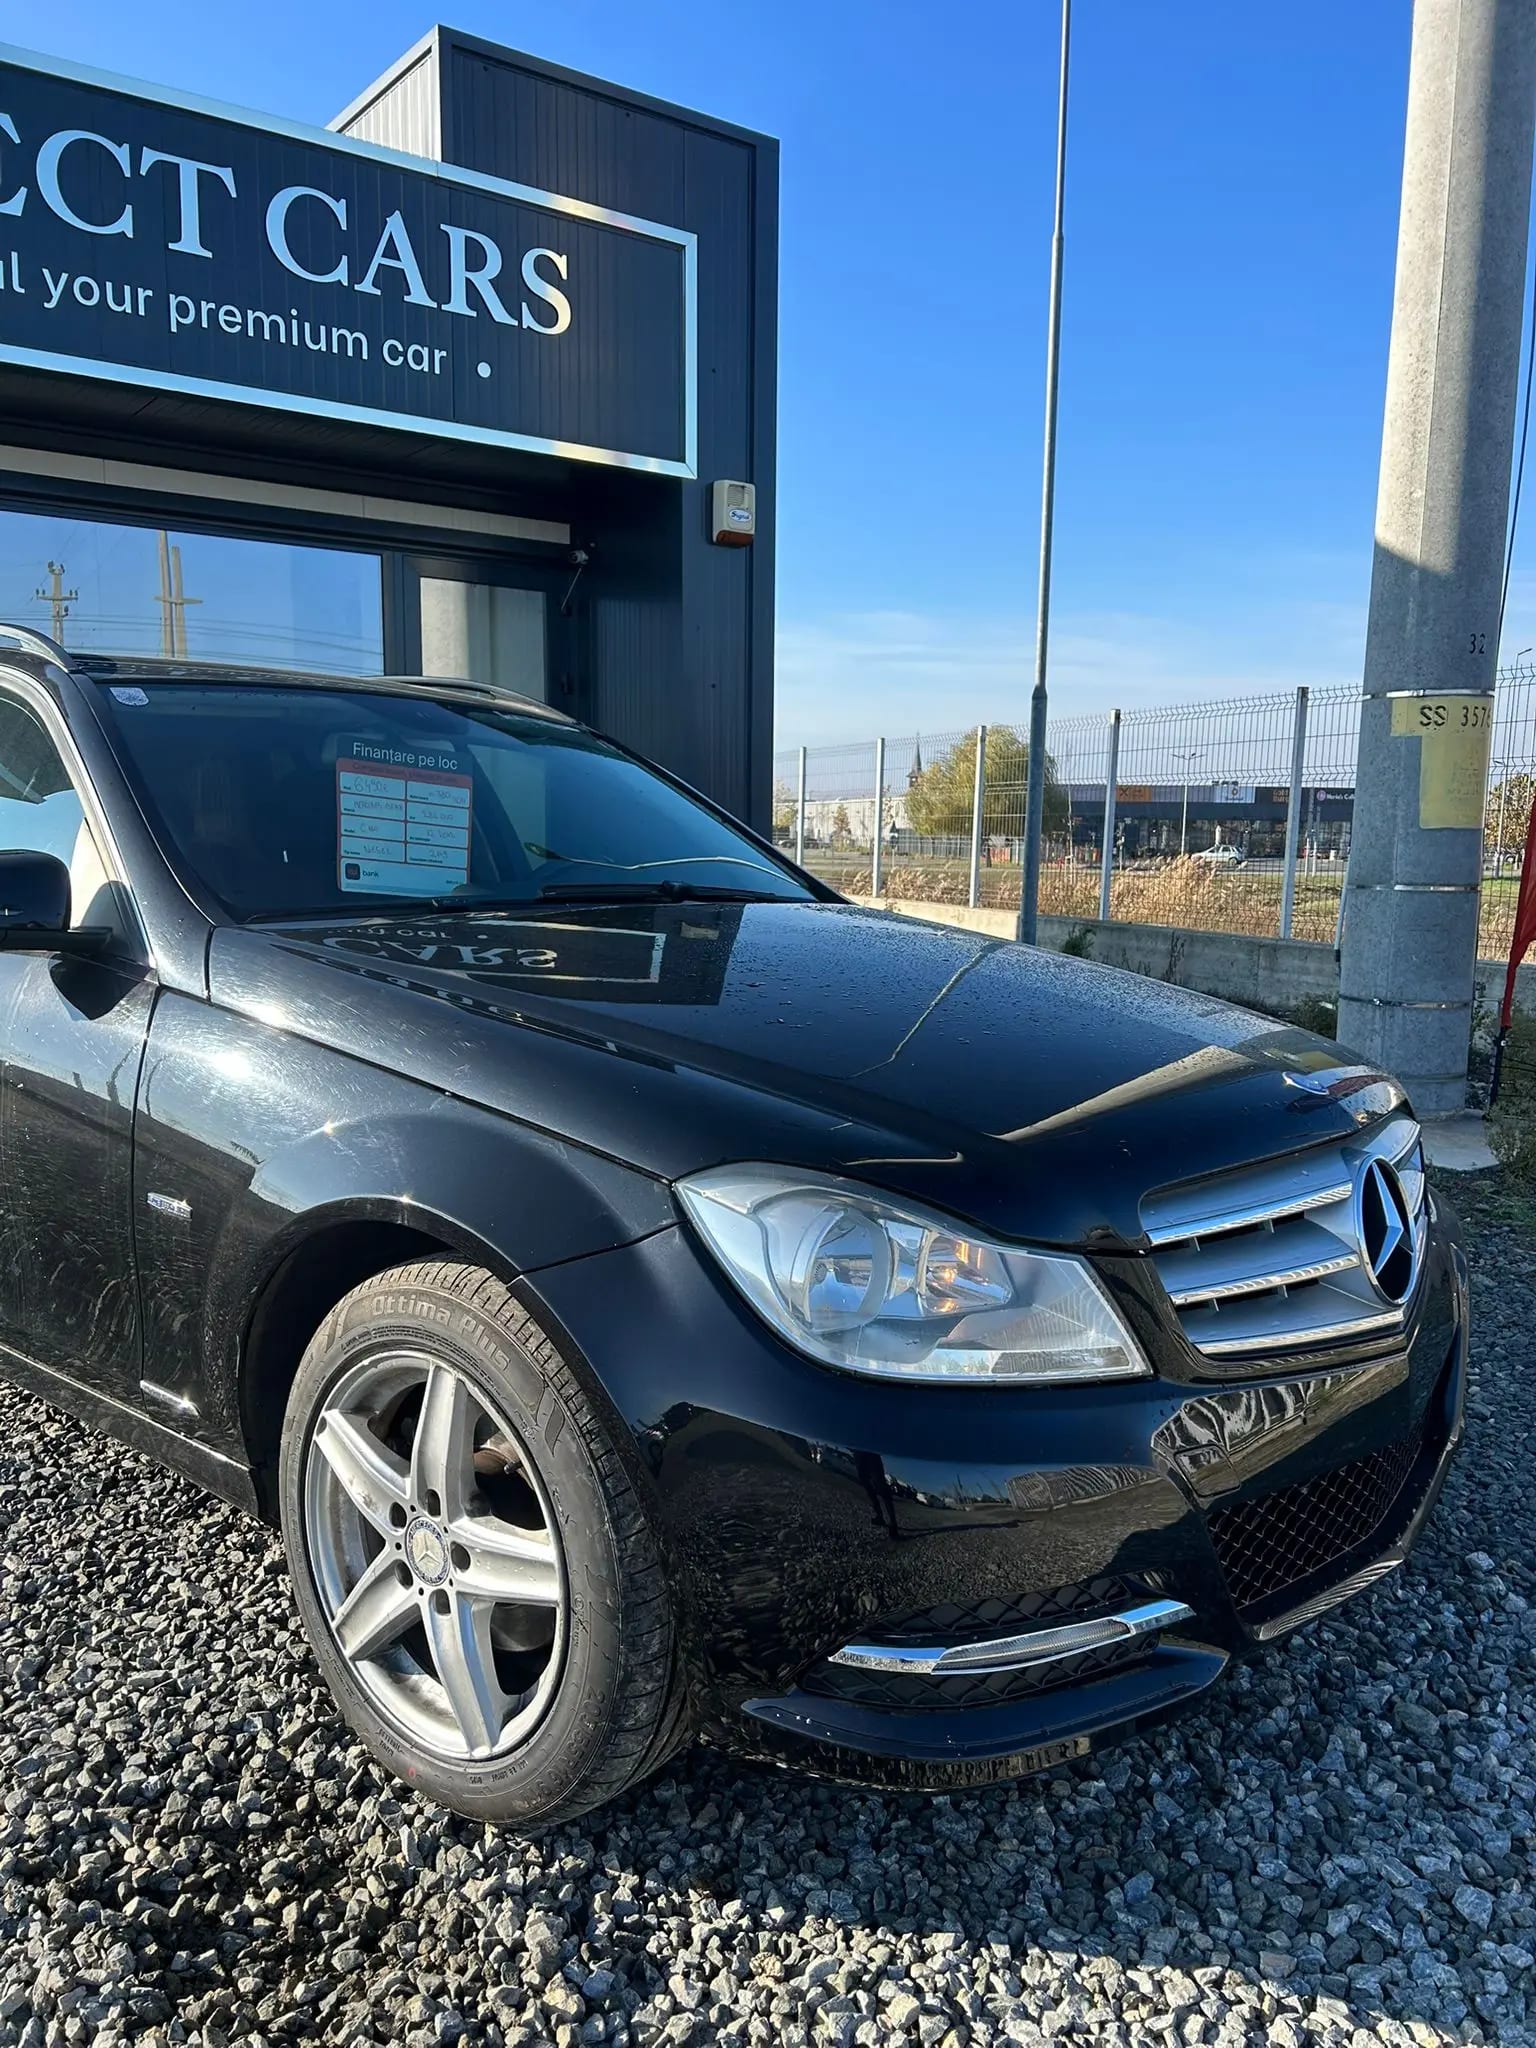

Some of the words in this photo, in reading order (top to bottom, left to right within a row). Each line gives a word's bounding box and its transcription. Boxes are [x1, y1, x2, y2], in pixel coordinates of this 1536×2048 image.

[0, 112, 237, 259] CT
[265, 186, 571, 335] CARS
[0, 251, 25, 294] l
[42, 267, 153, 316] your
[169, 292, 368, 360] premium
[382, 338, 447, 375] car
[1469, 632, 1486, 654] 32
[1420, 705, 1447, 727] SS
[353, 742, 415, 764] Finanțare
[418, 755, 435, 767] pe
[439, 756, 458, 770] loc
[362, 870, 379, 878] bank
[372, 1294, 450, 1326] Ottima
[459, 1313, 511, 1371] Plus
